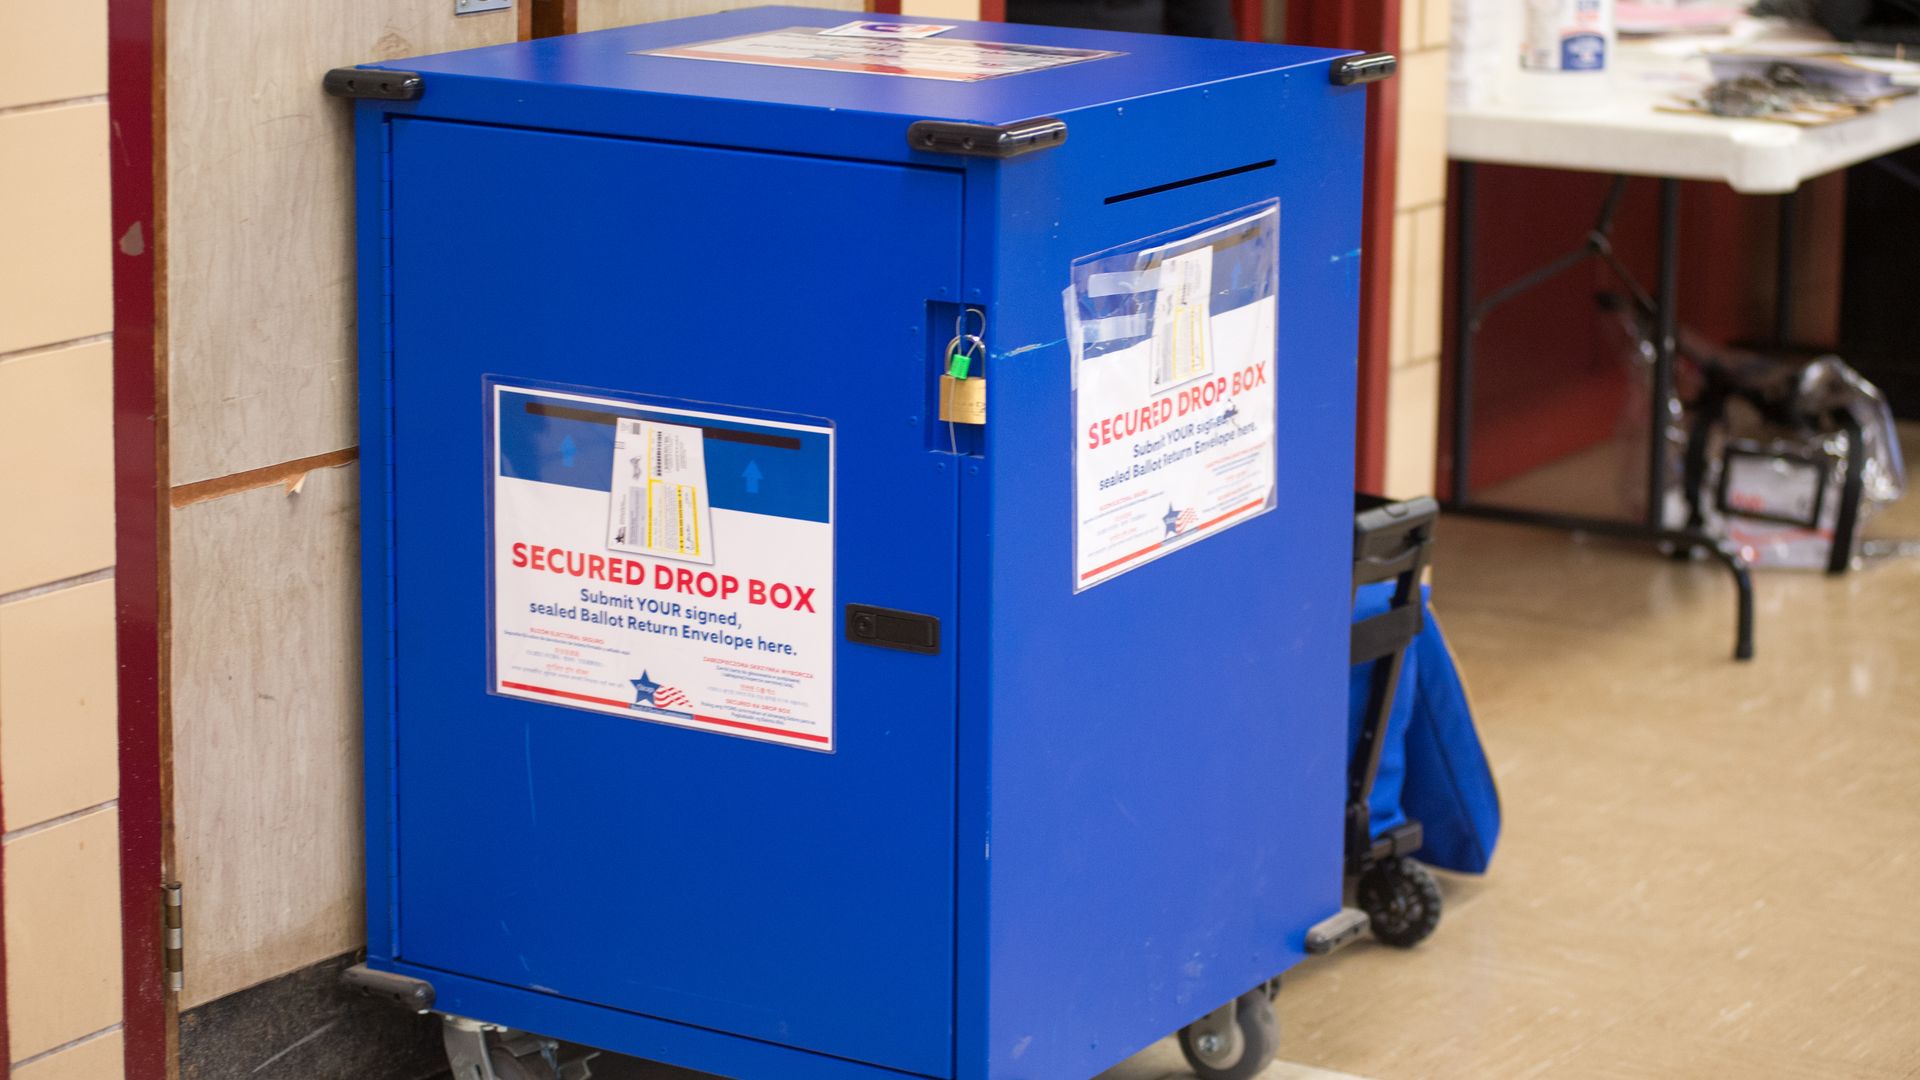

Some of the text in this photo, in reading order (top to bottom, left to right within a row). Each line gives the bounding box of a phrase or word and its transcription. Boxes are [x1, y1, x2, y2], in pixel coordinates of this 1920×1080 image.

[1088, 360, 1267, 450] SECURED DROP BOX
[1099, 466, 1131, 491] sealed
[1133, 458, 1162, 478] Ballot
[1194, 430, 1235, 455] Envelope
[1133, 434, 1166, 458] Submit
[1167, 423, 1194, 442] YOUR
[512, 542, 816, 614] SECURED DROP BOX
[529, 602, 797, 656] sealed Ballot Return Envelope here.
[580, 588, 742, 629] Submit YOUR signed,
